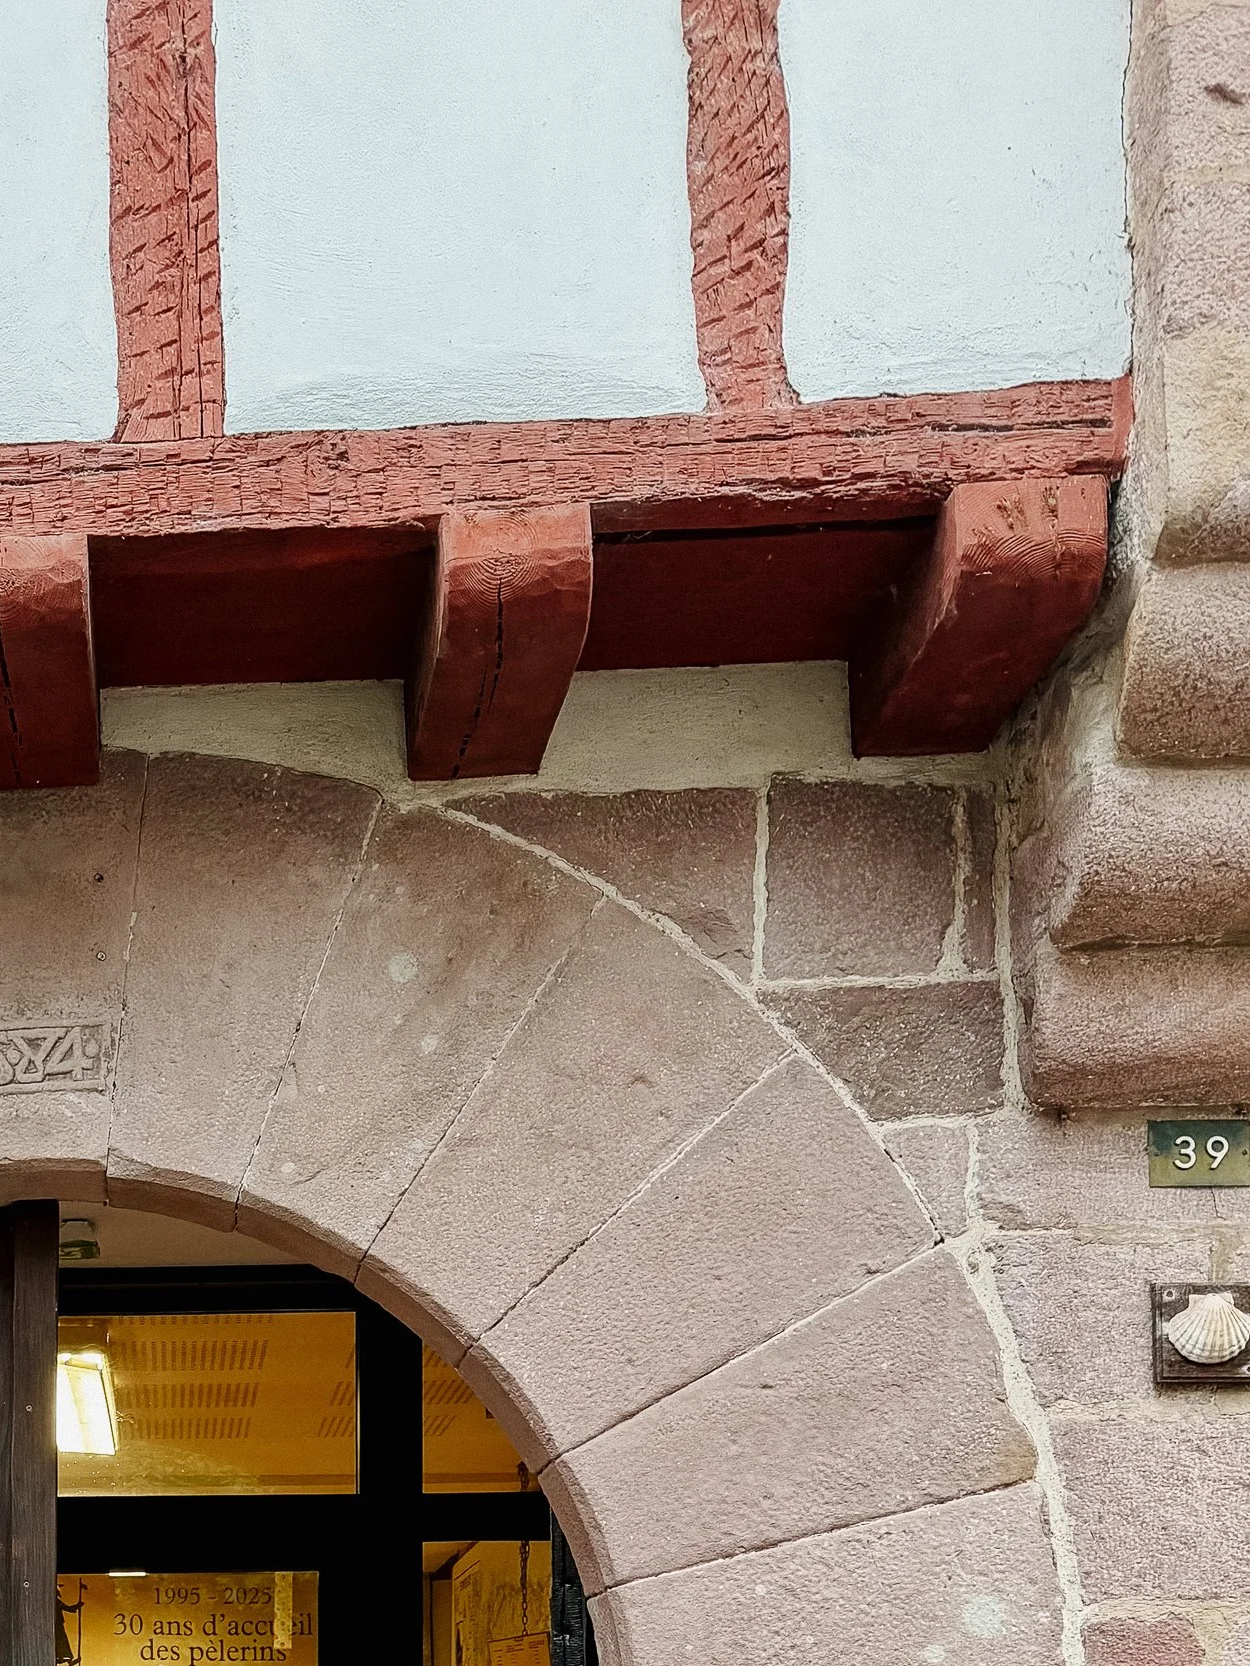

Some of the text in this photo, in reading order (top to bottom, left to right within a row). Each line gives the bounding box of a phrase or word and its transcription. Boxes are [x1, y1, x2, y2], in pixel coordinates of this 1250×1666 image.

[1172, 1135, 1230, 1170] 39
[154, 1587, 200, 1605] 1995
[223, 1586, 272, 1605] 2025
[113, 1613, 144, 1636] 30
[153, 1619, 194, 1636] ans
[140, 1637, 287, 1666] des pèlerins
